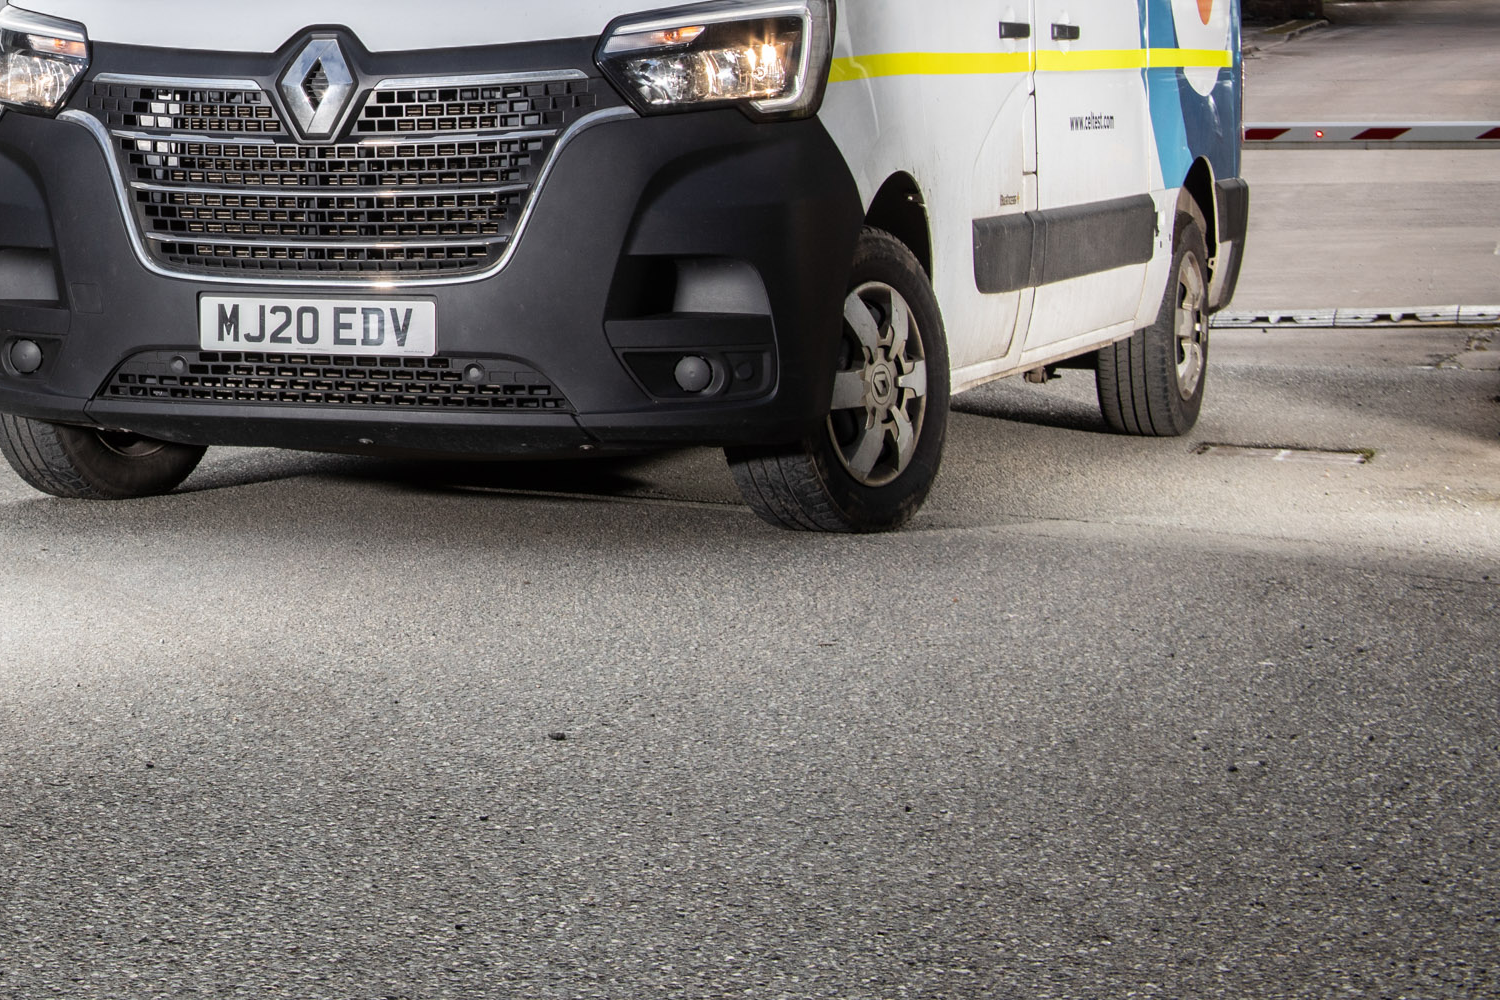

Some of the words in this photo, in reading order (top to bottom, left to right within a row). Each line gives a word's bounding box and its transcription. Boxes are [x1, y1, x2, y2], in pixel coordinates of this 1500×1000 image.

[1069, 111, 1115, 131] www.celtest.com
[217, 303, 320, 345] MJ20
[333, 306, 413, 347] EDV
